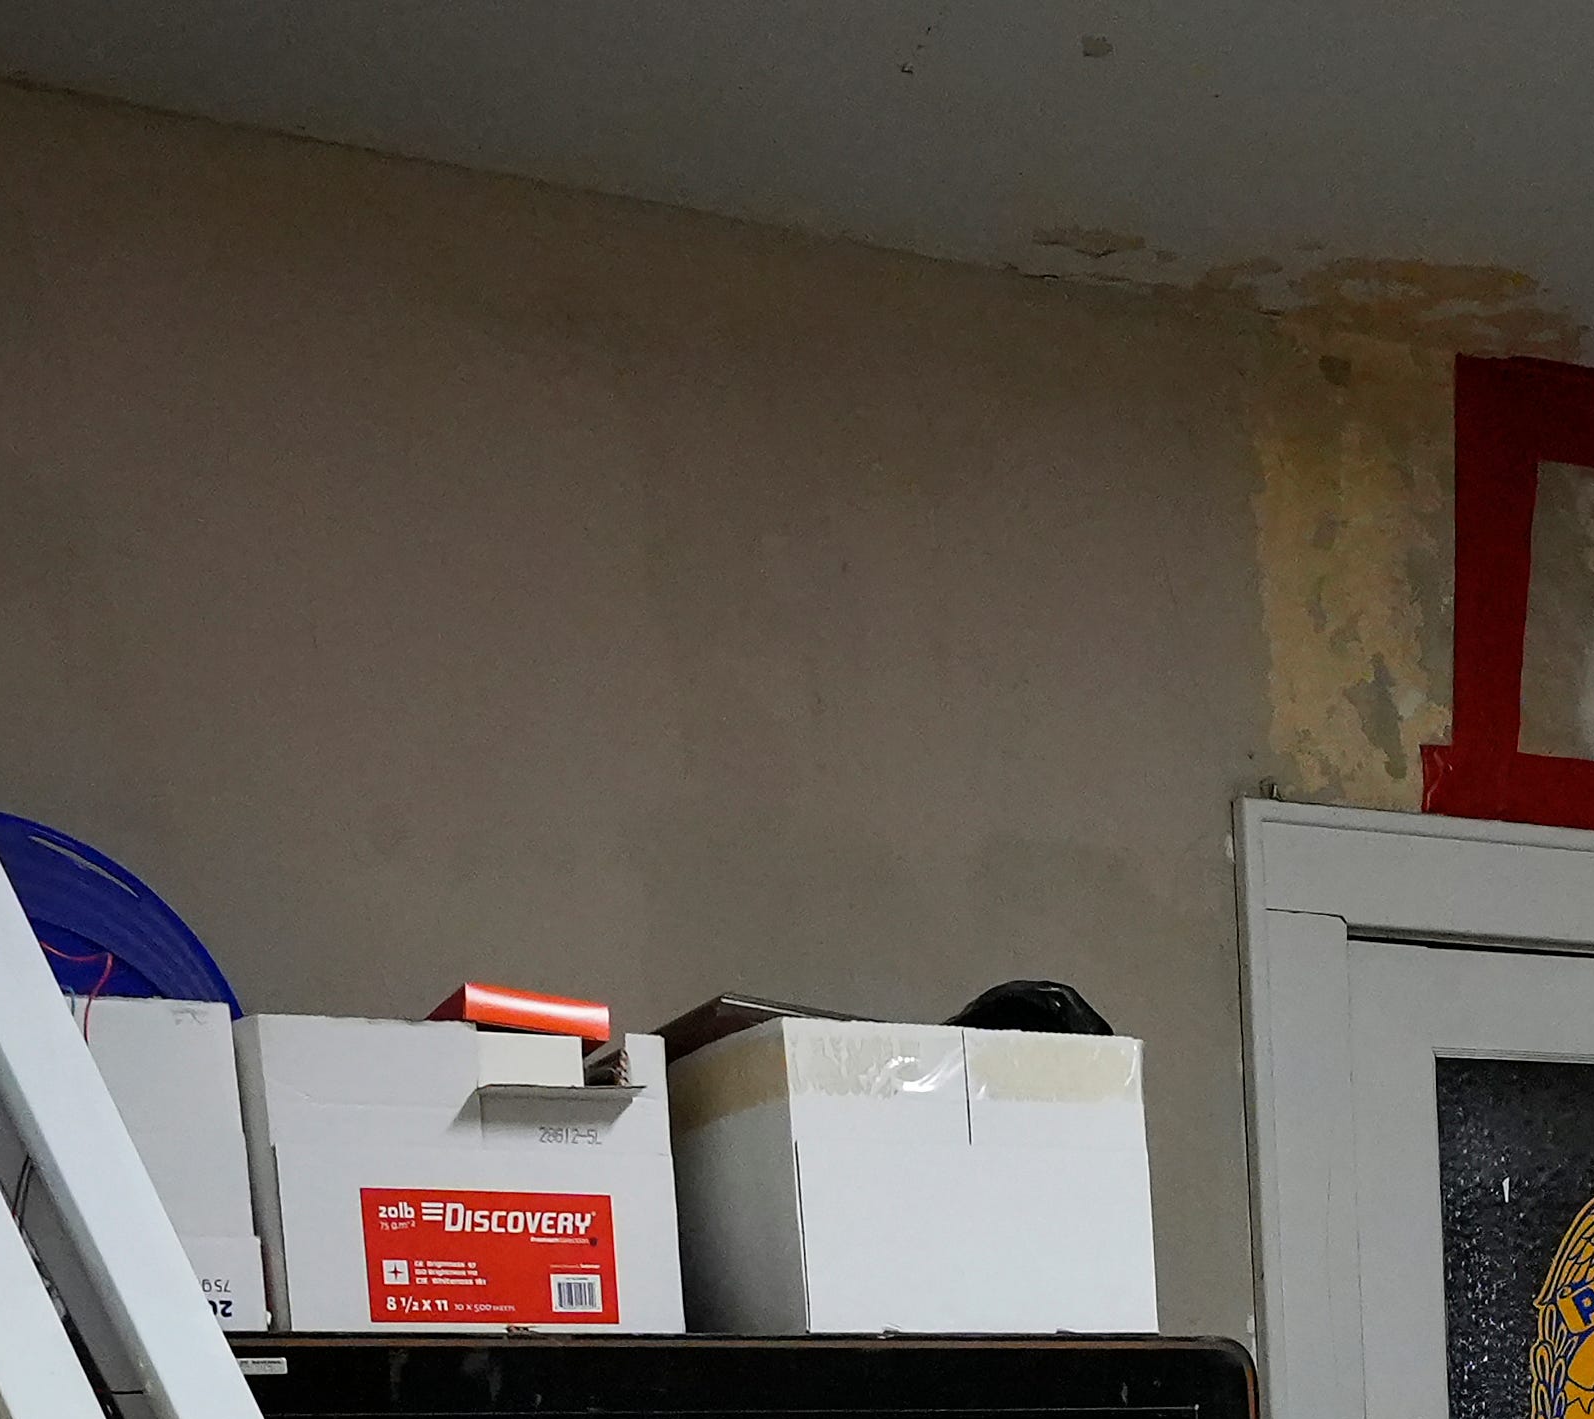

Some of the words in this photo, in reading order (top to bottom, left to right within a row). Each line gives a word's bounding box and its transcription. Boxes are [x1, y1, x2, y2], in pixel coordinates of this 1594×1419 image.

[378, 1201, 415, 1219] 20lb
[444, 1202, 593, 1235] DISCOVERY
[386, 1296, 397, 1311] 8
[435, 1299, 449, 1311] 11
[474, 1304, 492, 1313] 500
